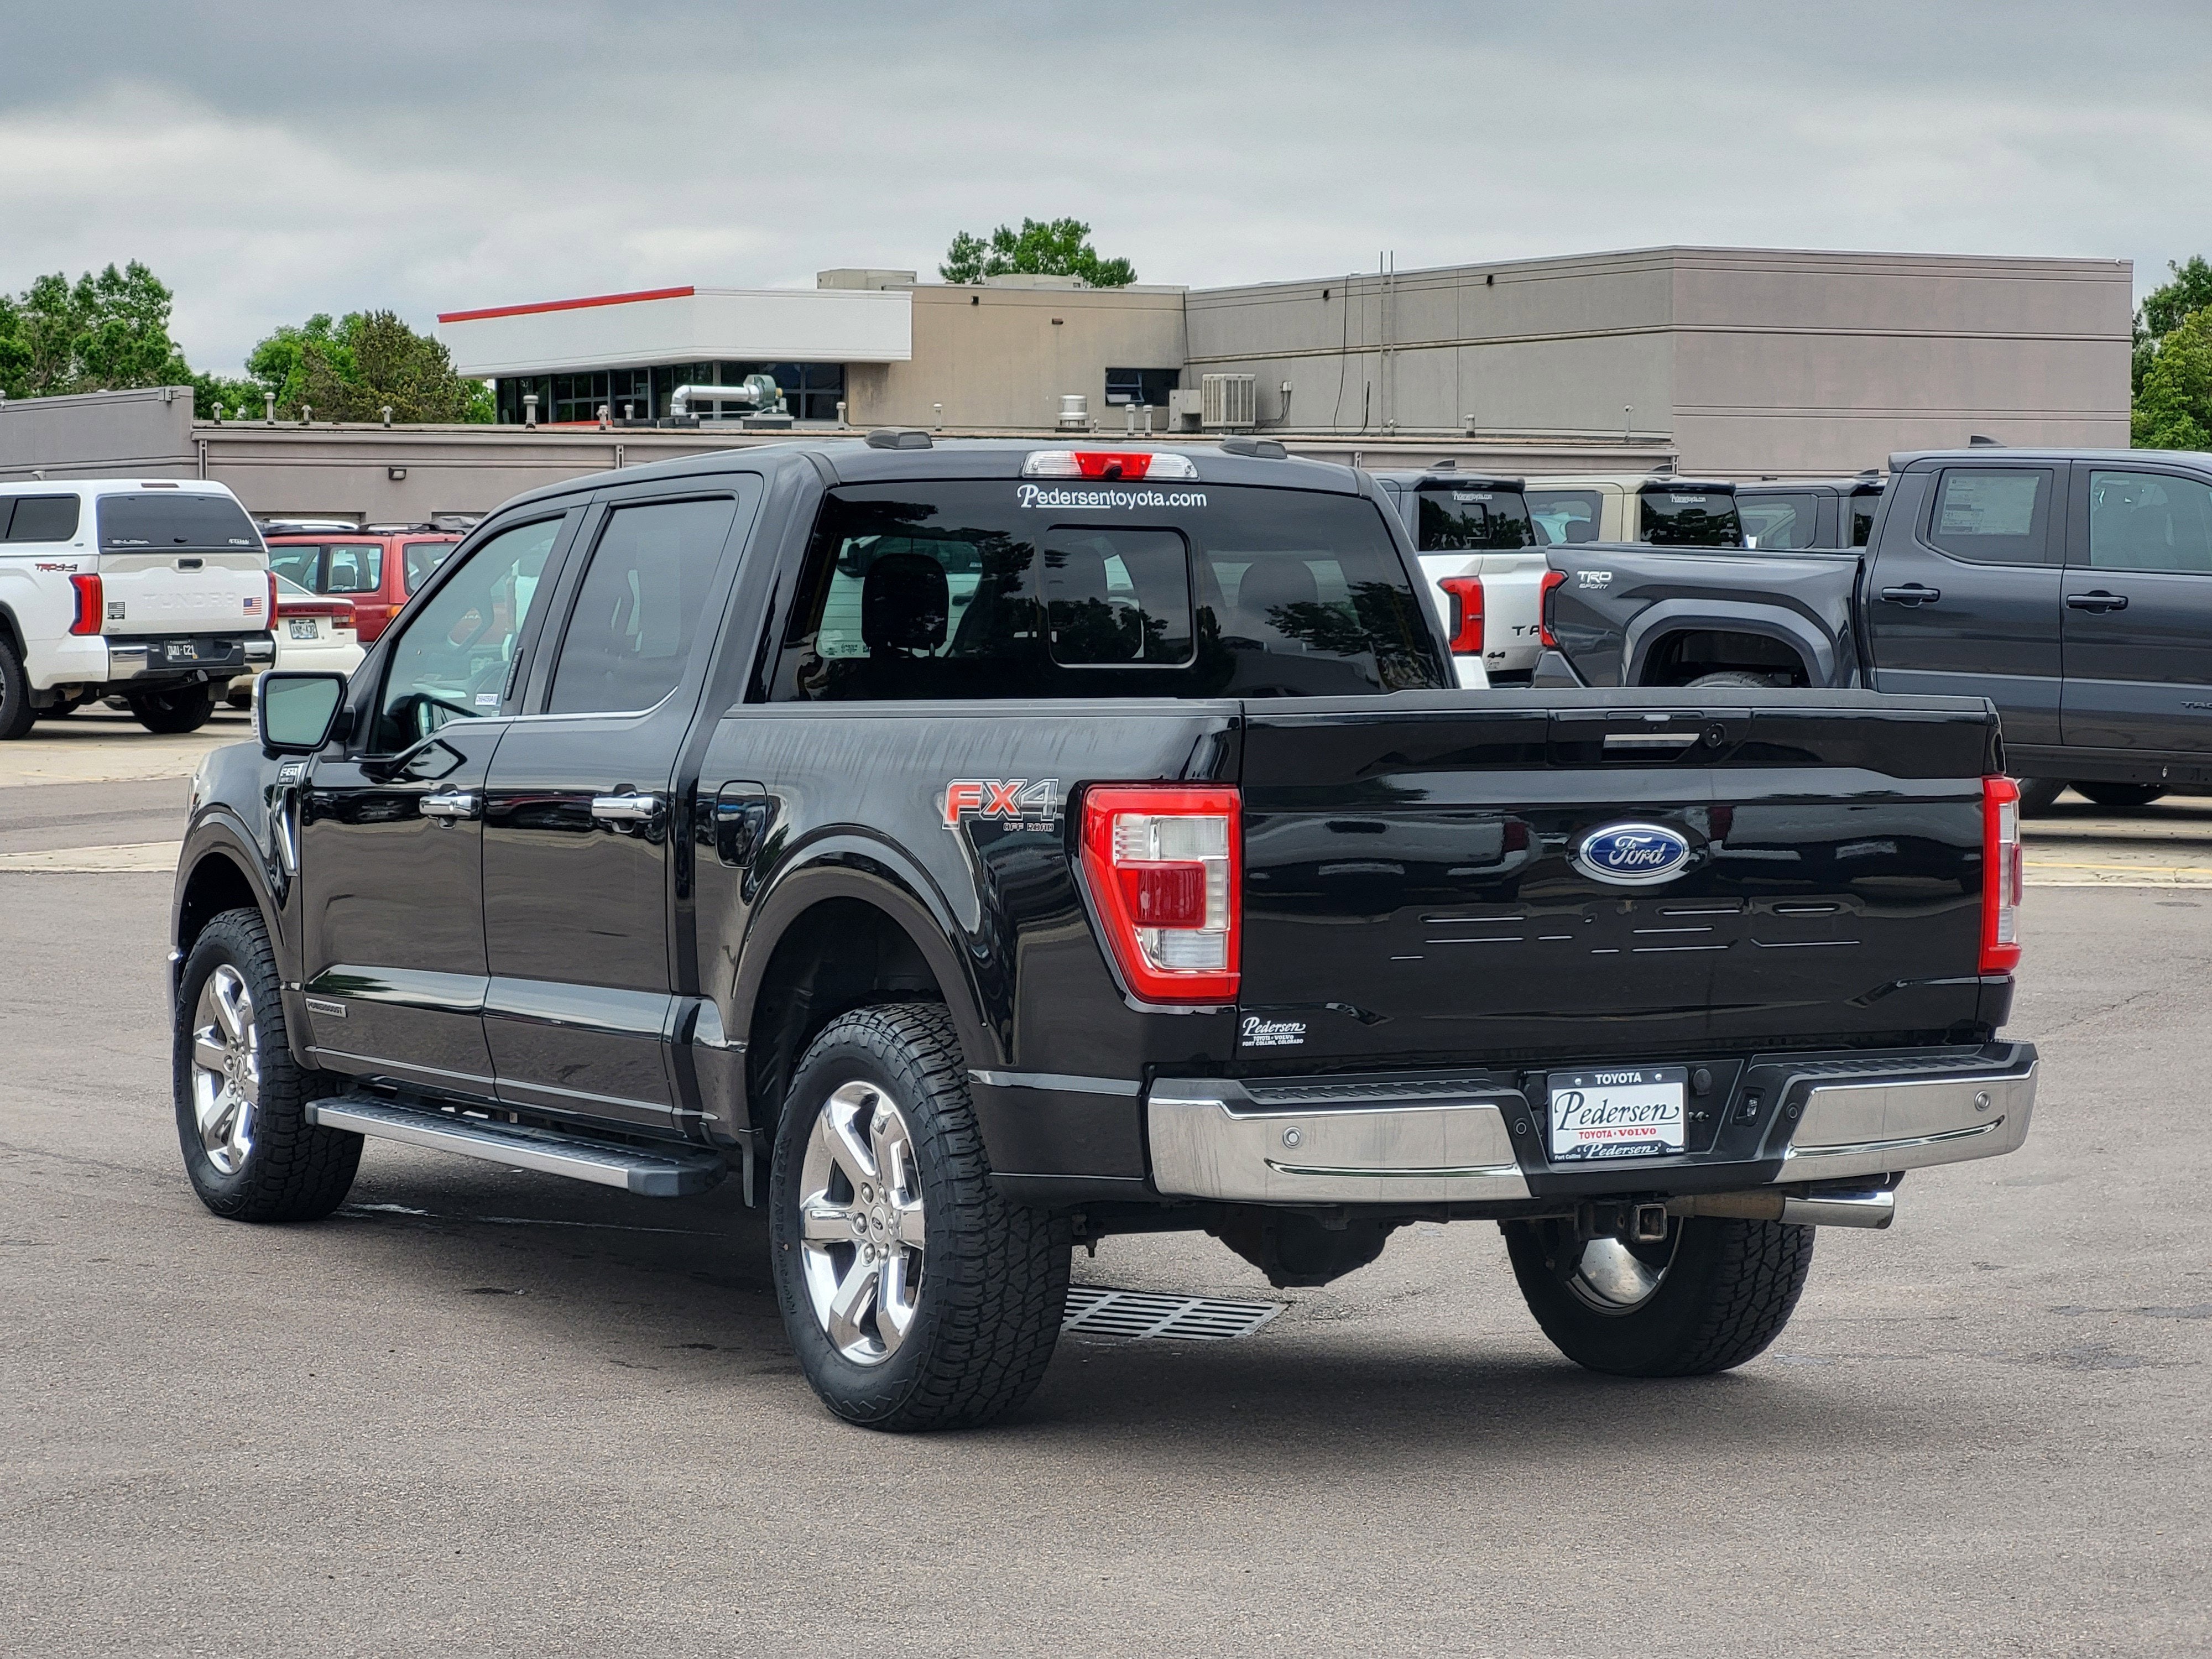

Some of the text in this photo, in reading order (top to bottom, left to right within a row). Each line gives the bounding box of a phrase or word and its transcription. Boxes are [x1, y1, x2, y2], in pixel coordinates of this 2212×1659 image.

[1016, 484, 1207, 509] Pedersentoyota.com
[1577, 571, 1613, 583] TRD
[942, 779, 1059, 830] FX4
[1003, 822, 1055, 832] OFF ROAD
[1609, 836, 1667, 865] Ford
[1242, 1016, 1306, 1036] Pedersen
[1595, 1072, 1642, 1085] TOYOTA
[1554, 1091, 1680, 1131] Pedersen
[1579, 1128, 1657, 1140] TOYOTA VOLVO
[1583, 1142, 1659, 1159] Pedersen
